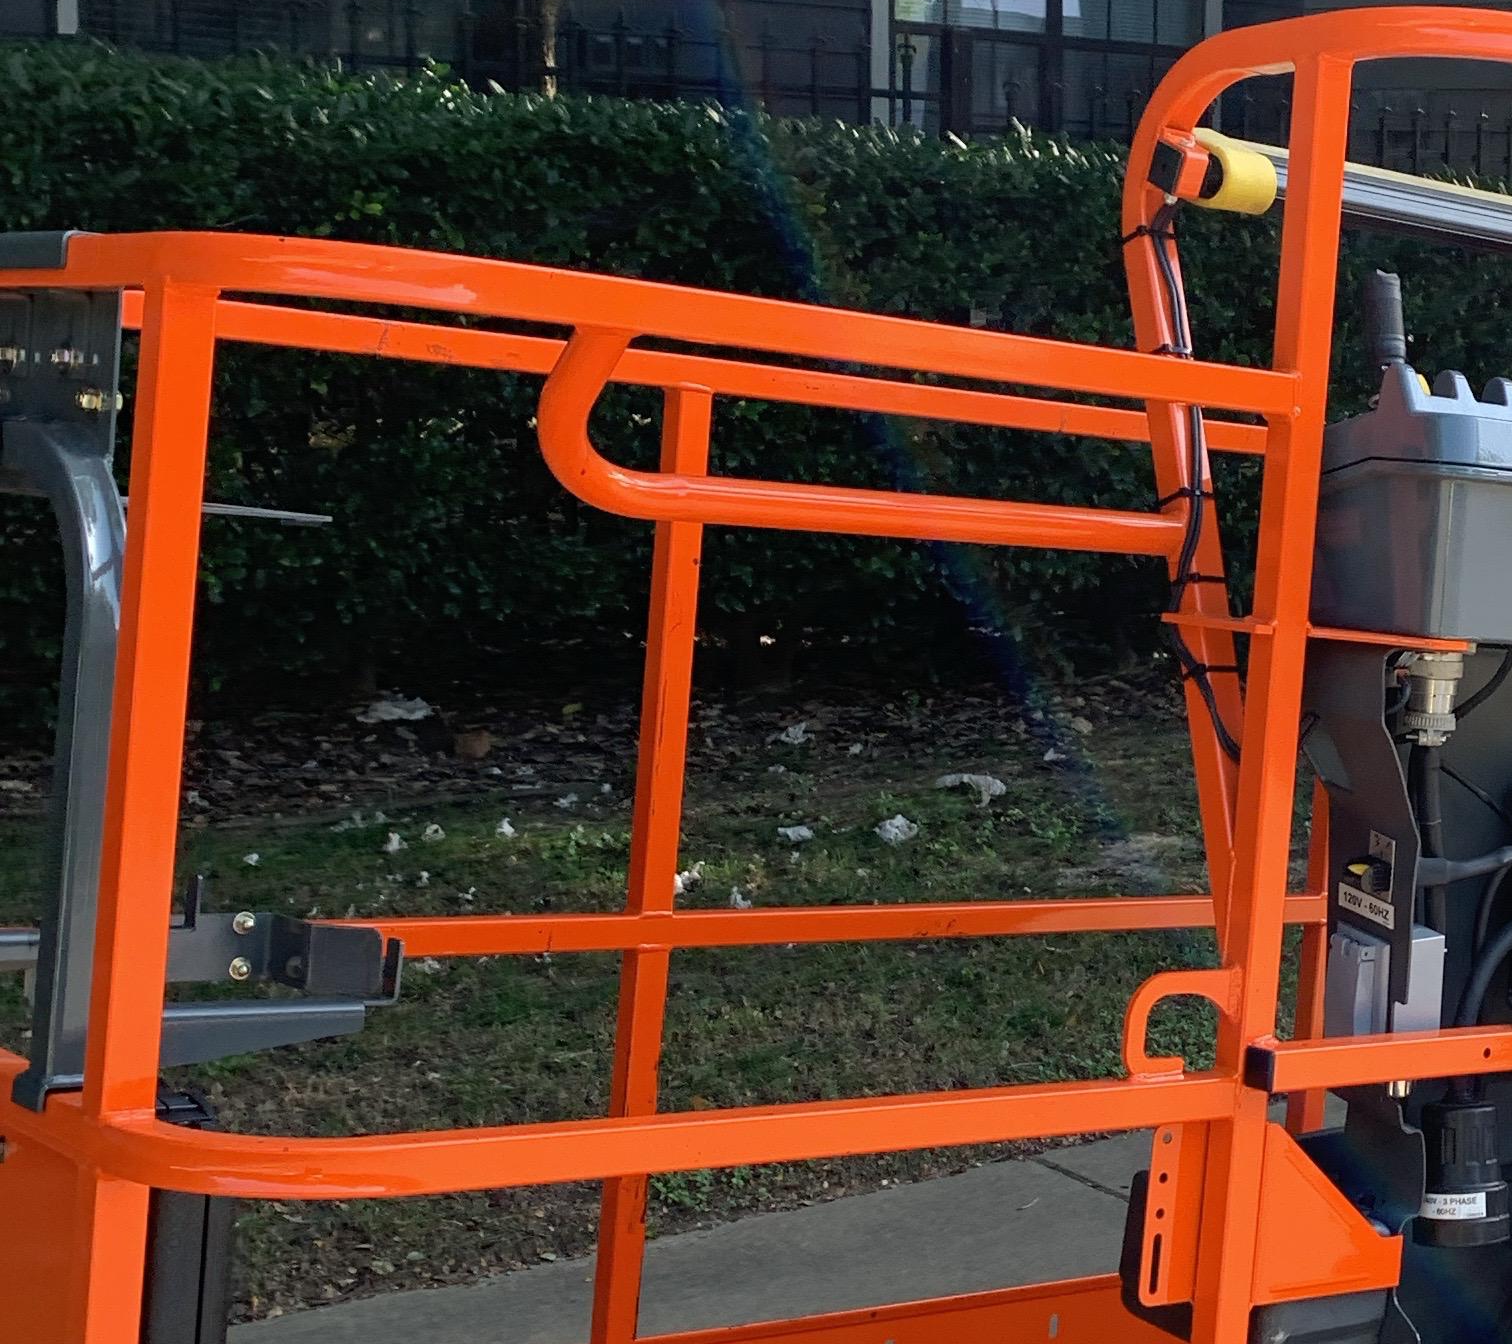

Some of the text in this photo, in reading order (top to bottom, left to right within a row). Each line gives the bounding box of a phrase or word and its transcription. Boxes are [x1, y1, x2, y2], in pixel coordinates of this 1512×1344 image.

[1343, 891, 1363, 908] 120V
[1368, 902, 1390, 921] 60HZ
[1449, 1196, 1478, 1206] PHASE
